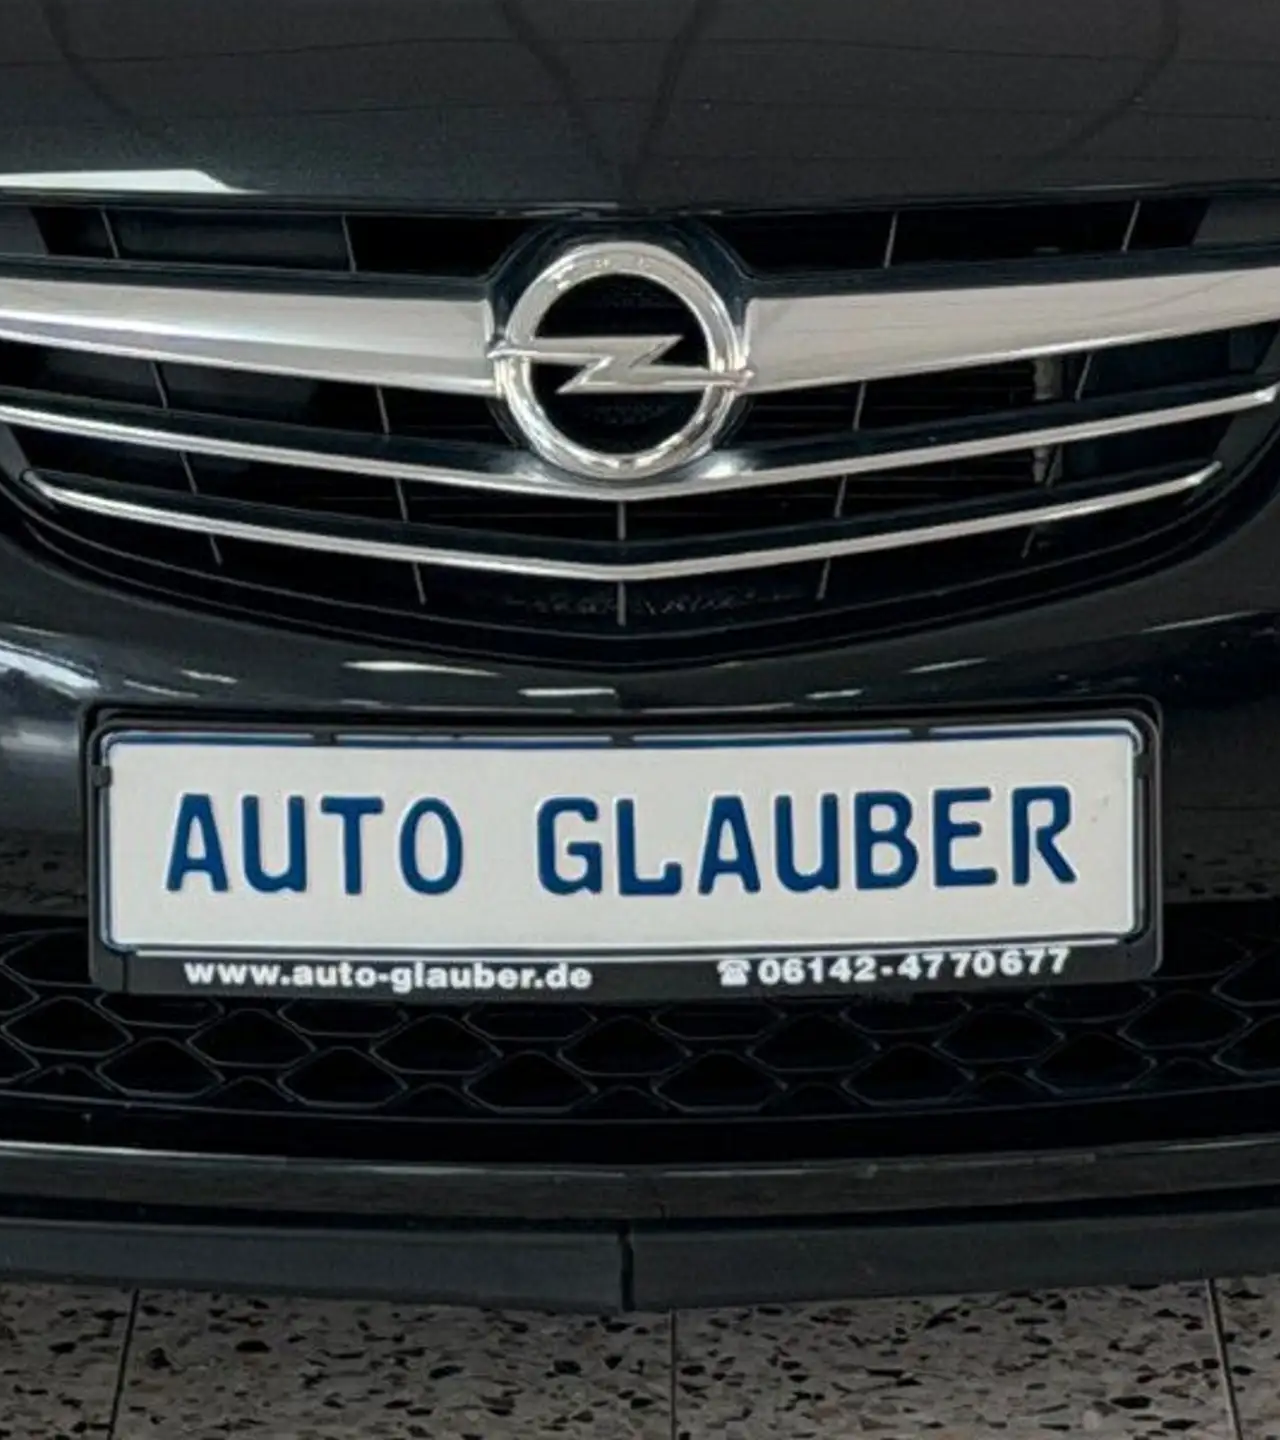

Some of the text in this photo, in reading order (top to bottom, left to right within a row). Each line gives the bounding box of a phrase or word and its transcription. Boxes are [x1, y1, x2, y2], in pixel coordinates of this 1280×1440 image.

[165, 786, 1078, 898] AUTO GLAUBER
[184, 961, 593, 994] www.auto-glauber.de
[758, 946, 1069, 987] 06142-4770677
